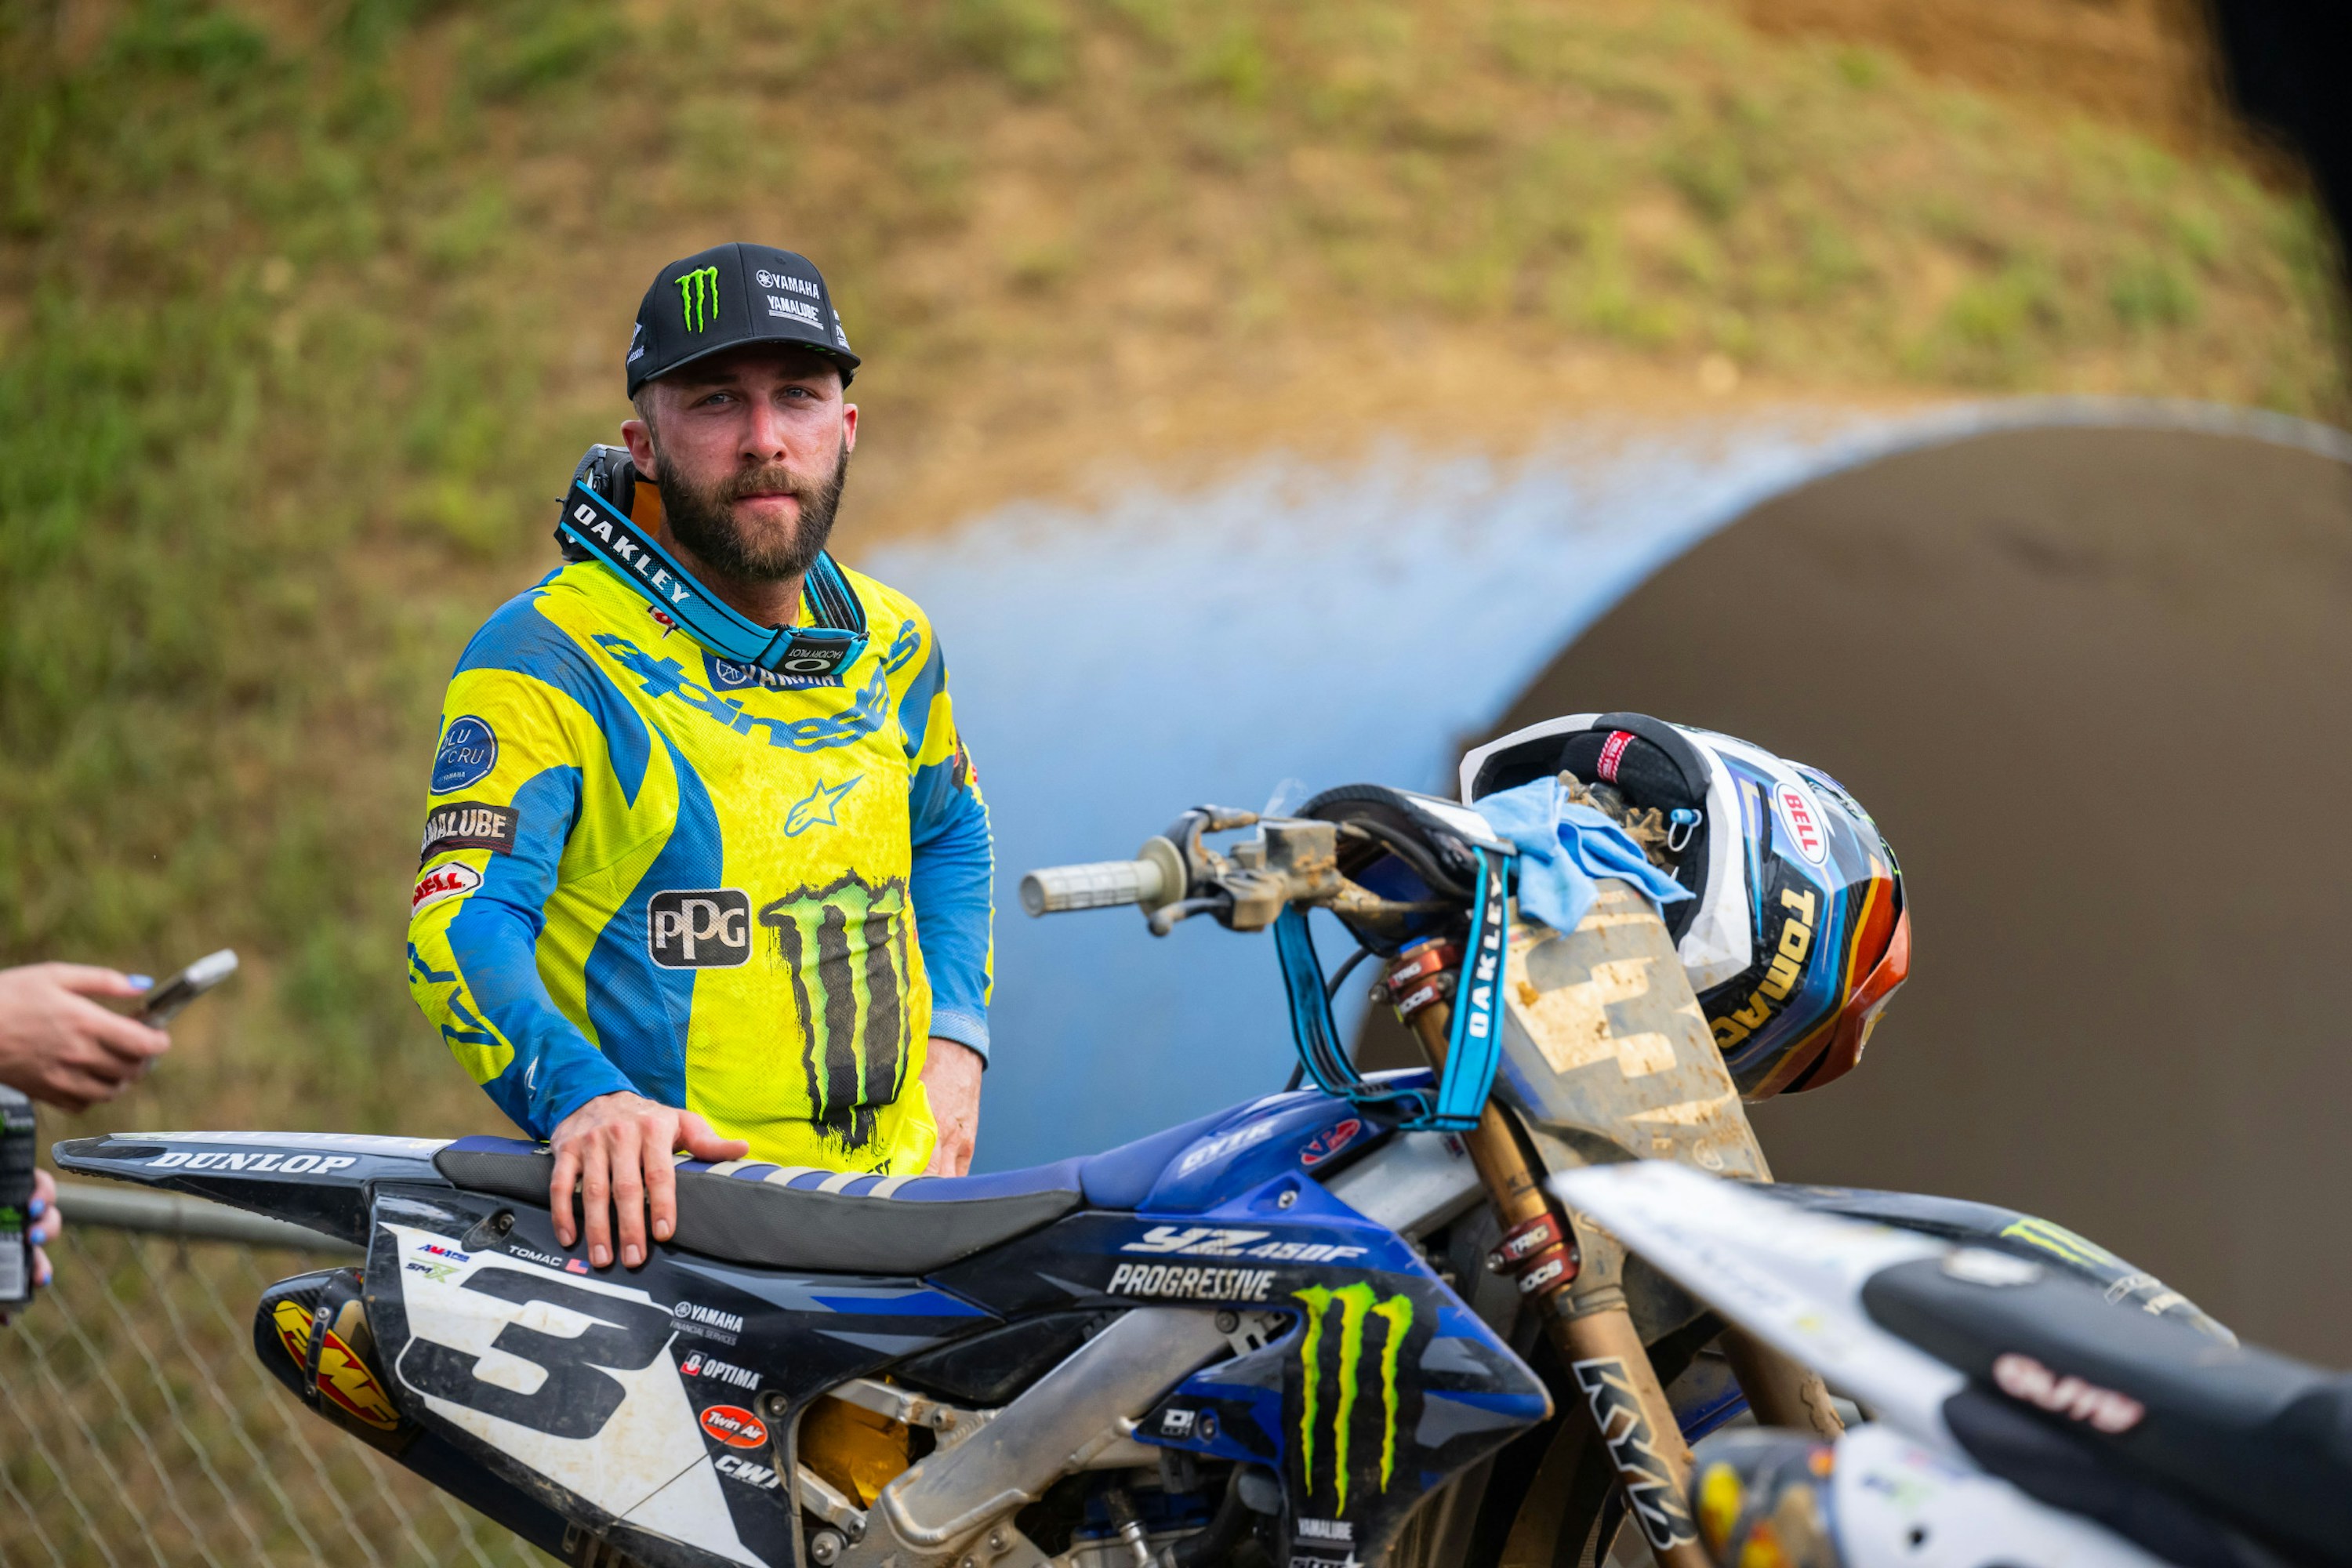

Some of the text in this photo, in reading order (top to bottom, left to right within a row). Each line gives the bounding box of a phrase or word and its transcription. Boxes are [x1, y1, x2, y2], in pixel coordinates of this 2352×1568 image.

[766, 295, 819, 321] YAMALUBE
[772, 274, 820, 299] YAMAHA
[573, 503, 691, 604] OAKLEY
[590, 619, 922, 753] alpinestas
[420, 808, 506, 861] MALUBE
[1783, 793, 1819, 852] BELL
[654, 898, 746, 960] PPG
[1469, 871, 1503, 1039] OAKLEY
[1711, 887, 1816, 1050] TOMAC
[146, 1152, 357, 1174] DUNLOP
[509, 1244, 562, 1267] TOMAC
[1120, 1225, 1369, 1262] YZ 450F
[1106, 1263, 1277, 1302] PROGRESSIVE
[691, 1305, 744, 1333] YAMAHA
[272, 1306, 401, 1424] FMF
[397, 1266, 675, 1439] 3
[702, 1359, 762, 1391] OPTIMA
[707, 1410, 764, 1440] Twin Air
[1571, 1356, 1698, 1551] KYB
